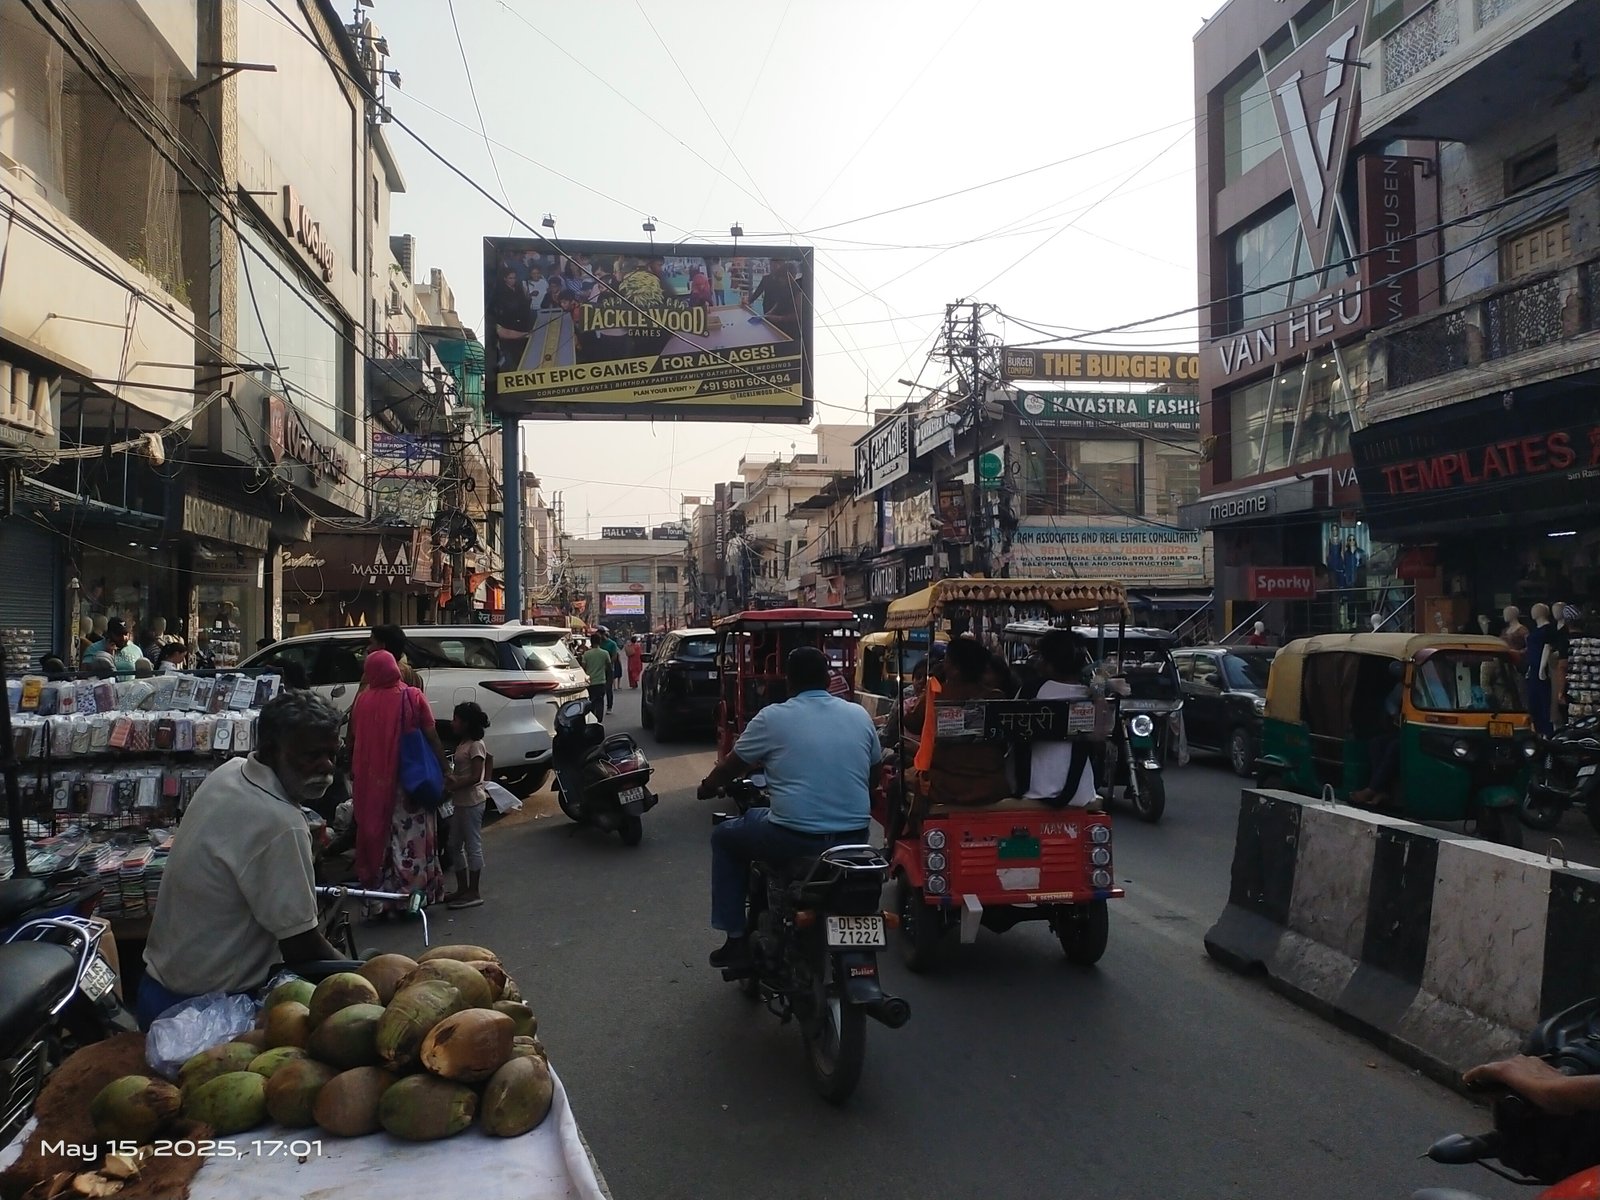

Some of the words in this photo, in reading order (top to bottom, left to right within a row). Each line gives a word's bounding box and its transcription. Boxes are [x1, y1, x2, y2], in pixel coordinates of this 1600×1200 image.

[1383, 158, 1402, 263] HEUSEN
[1387, 278, 1404, 323] VAN
[628, 329, 661, 338] GAMES
[1220, 322, 1278, 376] VAN
[1289, 280, 1363, 348] HEU
[661, 356, 695, 371] FOR
[698, 351, 726, 367] ALL
[729, 345, 777, 363] AGES!
[1007, 356, 1034, 368] BURGER
[1042, 353, 1082, 377] THE
[1086, 354, 1170, 379] BURGER
[504, 373, 546, 388] RENT
[550, 367, 588, 383] EPIC
[590, 361, 648, 378] GAMES
[537, 388, 579, 398] CORPORATE
[581, 384, 608, 393] EVENTS
[615, 379, 649, 390] BIRTHDAY
[651, 375, 674, 385] PARTY
[680, 371, 704, 381] FAMILY
[756, 362, 792, 373] WEDDINGS
[703, 380, 720, 392] +91
[722, 377, 745, 390] 9811
[770, 373, 791, 386] 494
[633, 389, 652, 397] PLAN
[652, 387, 668, 396] YOUR
[668, 385, 687, 394] EVENT
[1053, 397, 1138, 416] KAYASTRA
[871, 424, 908, 471] CANTABIL
[1381, 432, 1577, 496] TEMPLATES
[1337, 465, 1360, 489] VA
[1017, 532, 1034, 544] RAM
[1036, 532, 1080, 544] ASSOCIATES
[1081, 532, 1096, 544] AND
[1099, 532, 1119, 545] REAL
[1120, 532, 1148, 545] ESTATE
[1149, 531, 1199, 545] CONSULTANTS
[871, 567, 899, 597] CANTABIL
[908, 565, 933, 583] STATUS
[1257, 575, 1311, 592] Sparky
[838, 917, 879, 931] DL5SB
[839, 931, 880, 944] Z1224
